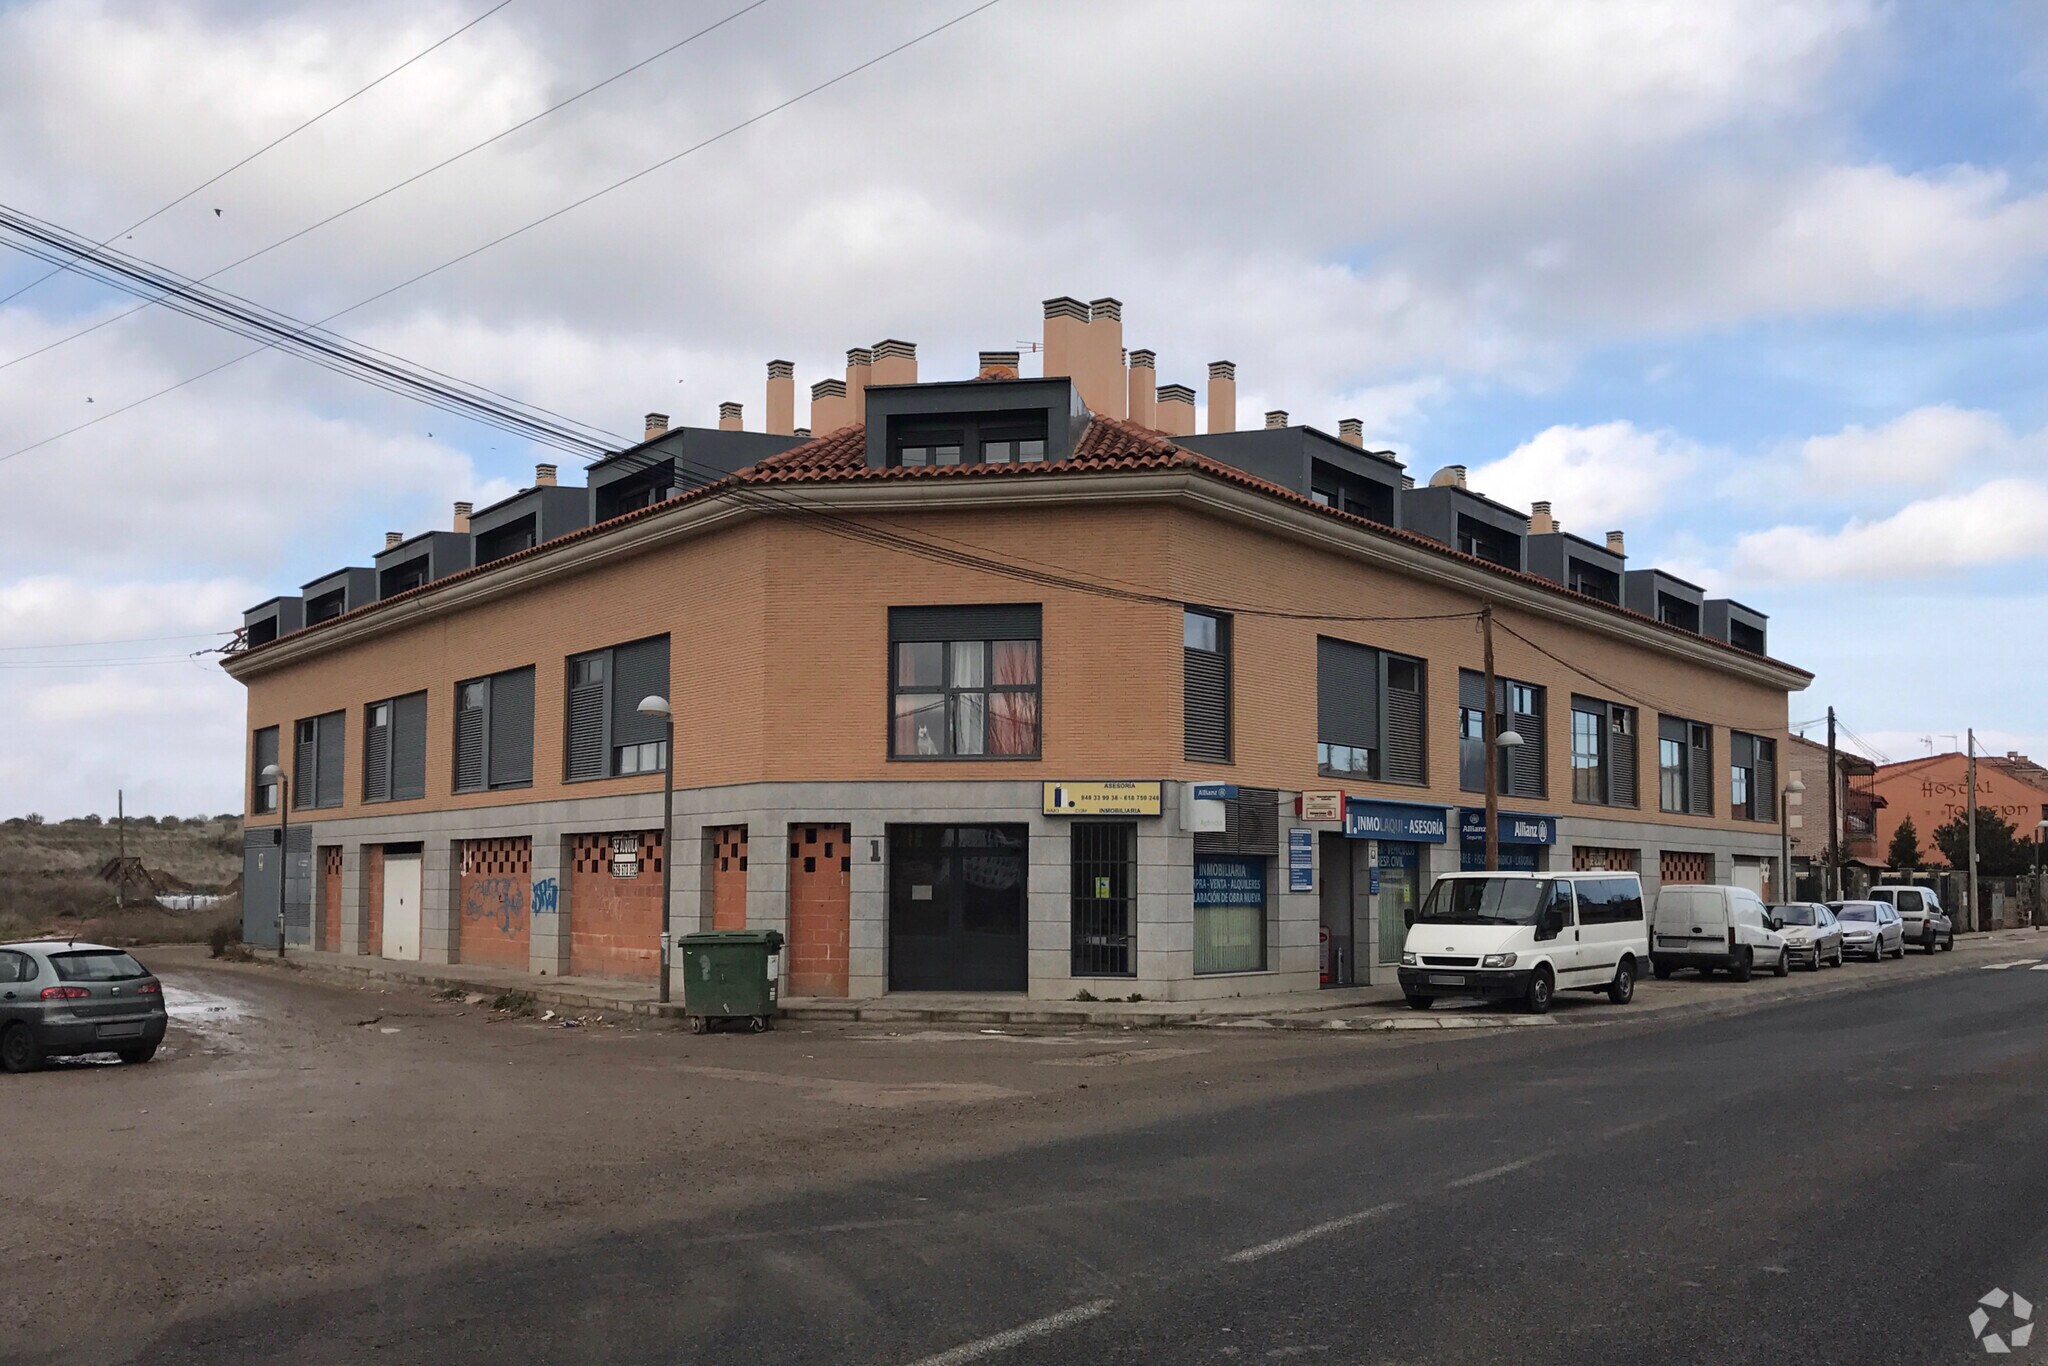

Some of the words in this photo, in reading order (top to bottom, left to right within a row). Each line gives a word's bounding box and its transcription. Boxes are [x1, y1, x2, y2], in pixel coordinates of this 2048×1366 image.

[1408, 818, 1445, 836] ASESORÍA
[1462, 825, 1487, 833] Allianz
[1514, 821, 1538, 838] Allianz
[870, 840, 881, 862] 1
[1199, 863, 1247, 877] INMOBILIARIA
[1210, 879, 1228, 889] VENTA
[1231, 880, 1261, 890] ALQUILERES
[1221, 893, 1229, 902] DE
